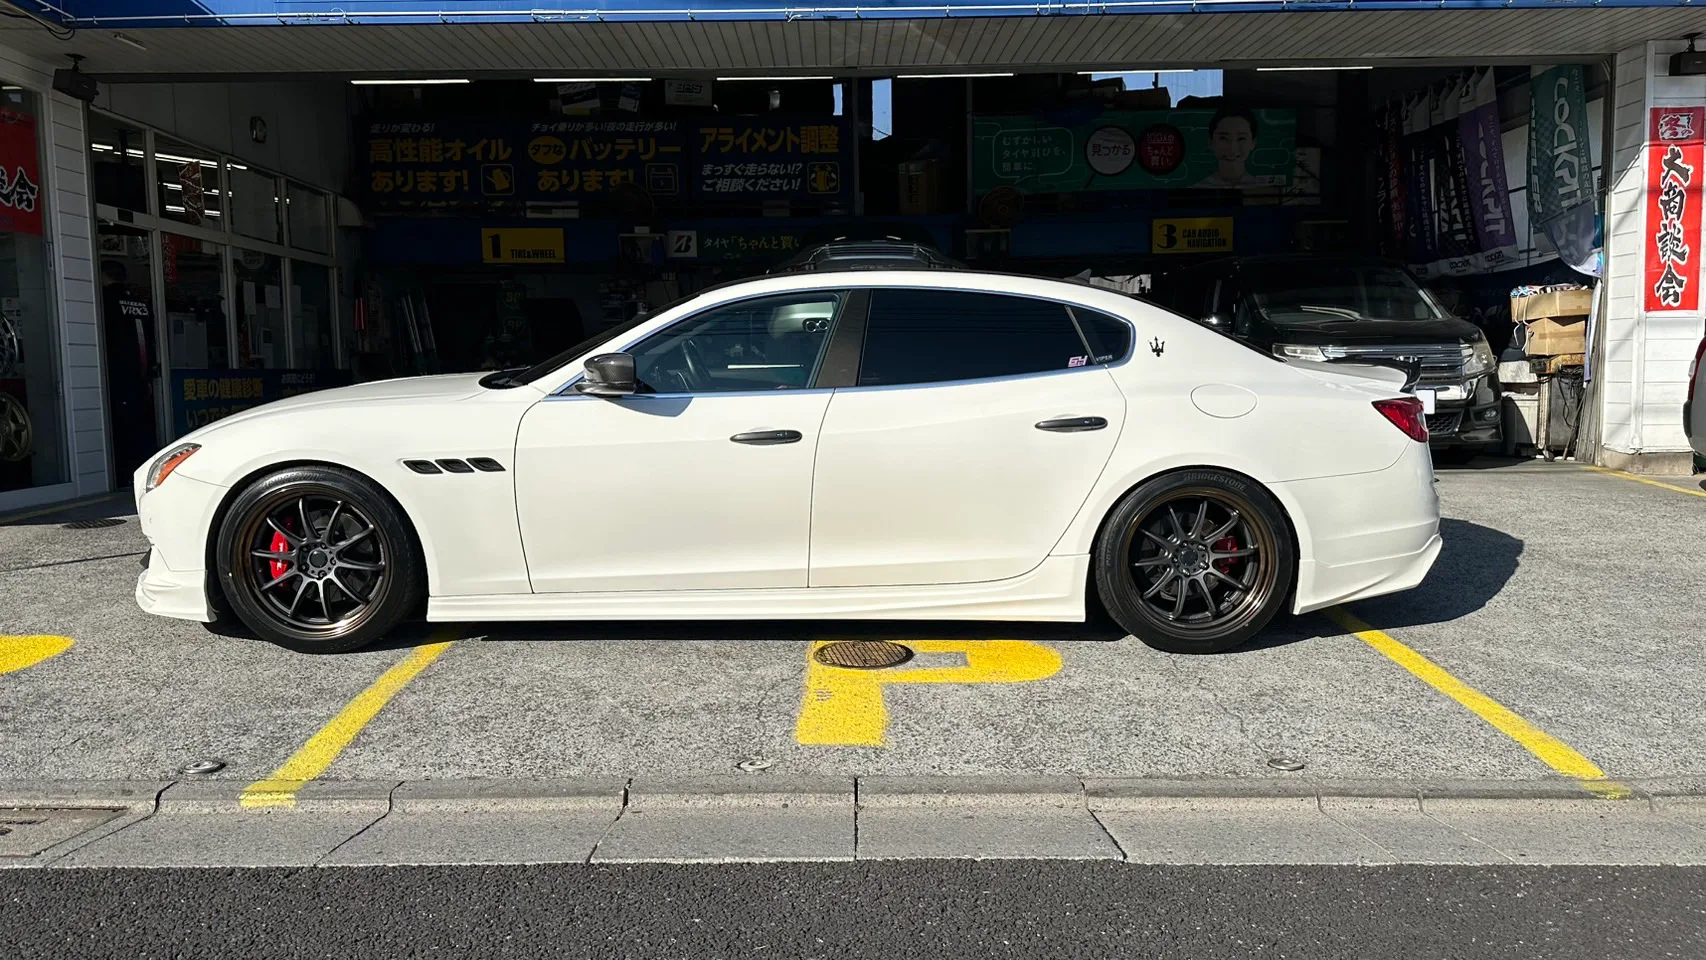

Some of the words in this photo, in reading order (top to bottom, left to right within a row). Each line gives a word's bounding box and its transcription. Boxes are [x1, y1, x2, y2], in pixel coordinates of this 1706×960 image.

[368, 135, 513, 164] 高性能オイル
[531, 143, 563, 156] タフな
[569, 135, 682, 161] バッテリー
[699, 124, 840, 154] アライメント調整
[1091, 143, 1131, 157] 見つかる
[1553, 77, 1582, 208] COCKPIT
[371, 168, 470, 193] あります!
[701, 163, 803, 176] まっすぐ走らない!?
[700, 177, 802, 193] ご相談ください!
[1157, 223, 1178, 249] 3
[1655, 145, 1693, 306] 大商談会
[488, 234, 501, 258] 1
[510, 248, 556, 259] TIRE&WHEEL
[1186, 237, 1227, 249] NAVIGATION
[184, 377, 263, 401] 愛車の健康診断
[1183, 472, 1247, 492] BRIDGESTONE
